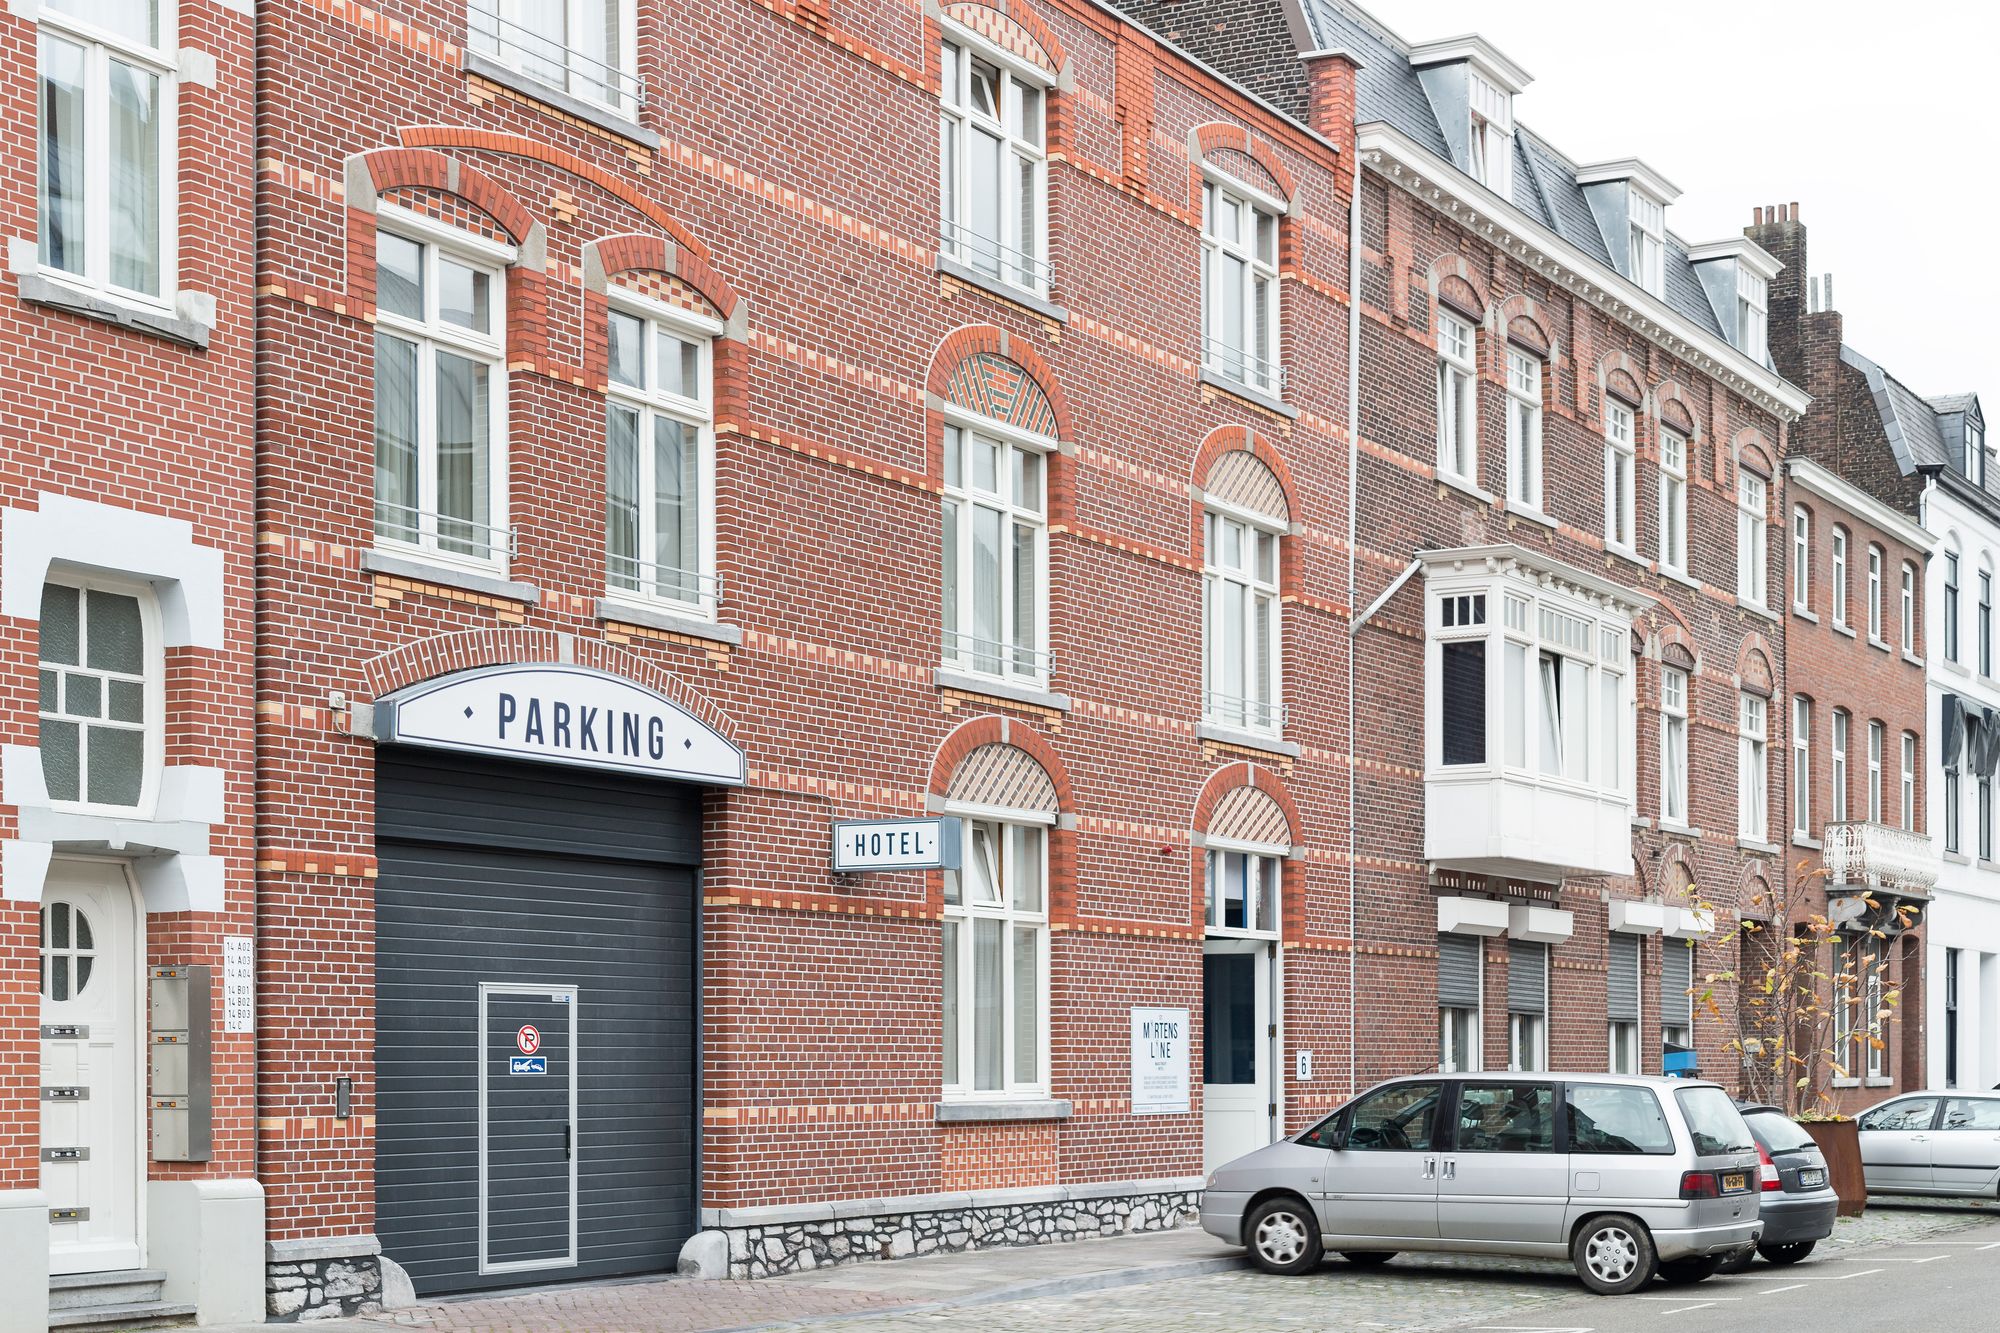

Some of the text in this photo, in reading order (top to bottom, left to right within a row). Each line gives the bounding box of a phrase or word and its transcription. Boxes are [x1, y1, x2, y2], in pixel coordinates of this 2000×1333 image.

[498, 692, 664, 760] PARKING
[855, 831, 924, 857] HOTEL
[226, 942, 251, 952] 14 A02
[227, 955, 251, 965] 14 A03
[227, 968, 251, 978] 14 A04
[228, 985, 250, 995] 14 B01
[228, 997, 236, 1006] 14
[228, 1009, 236, 1018] 14
[228, 1021, 236, 1030] 14
[1301, 1055, 1307, 1075] 6
